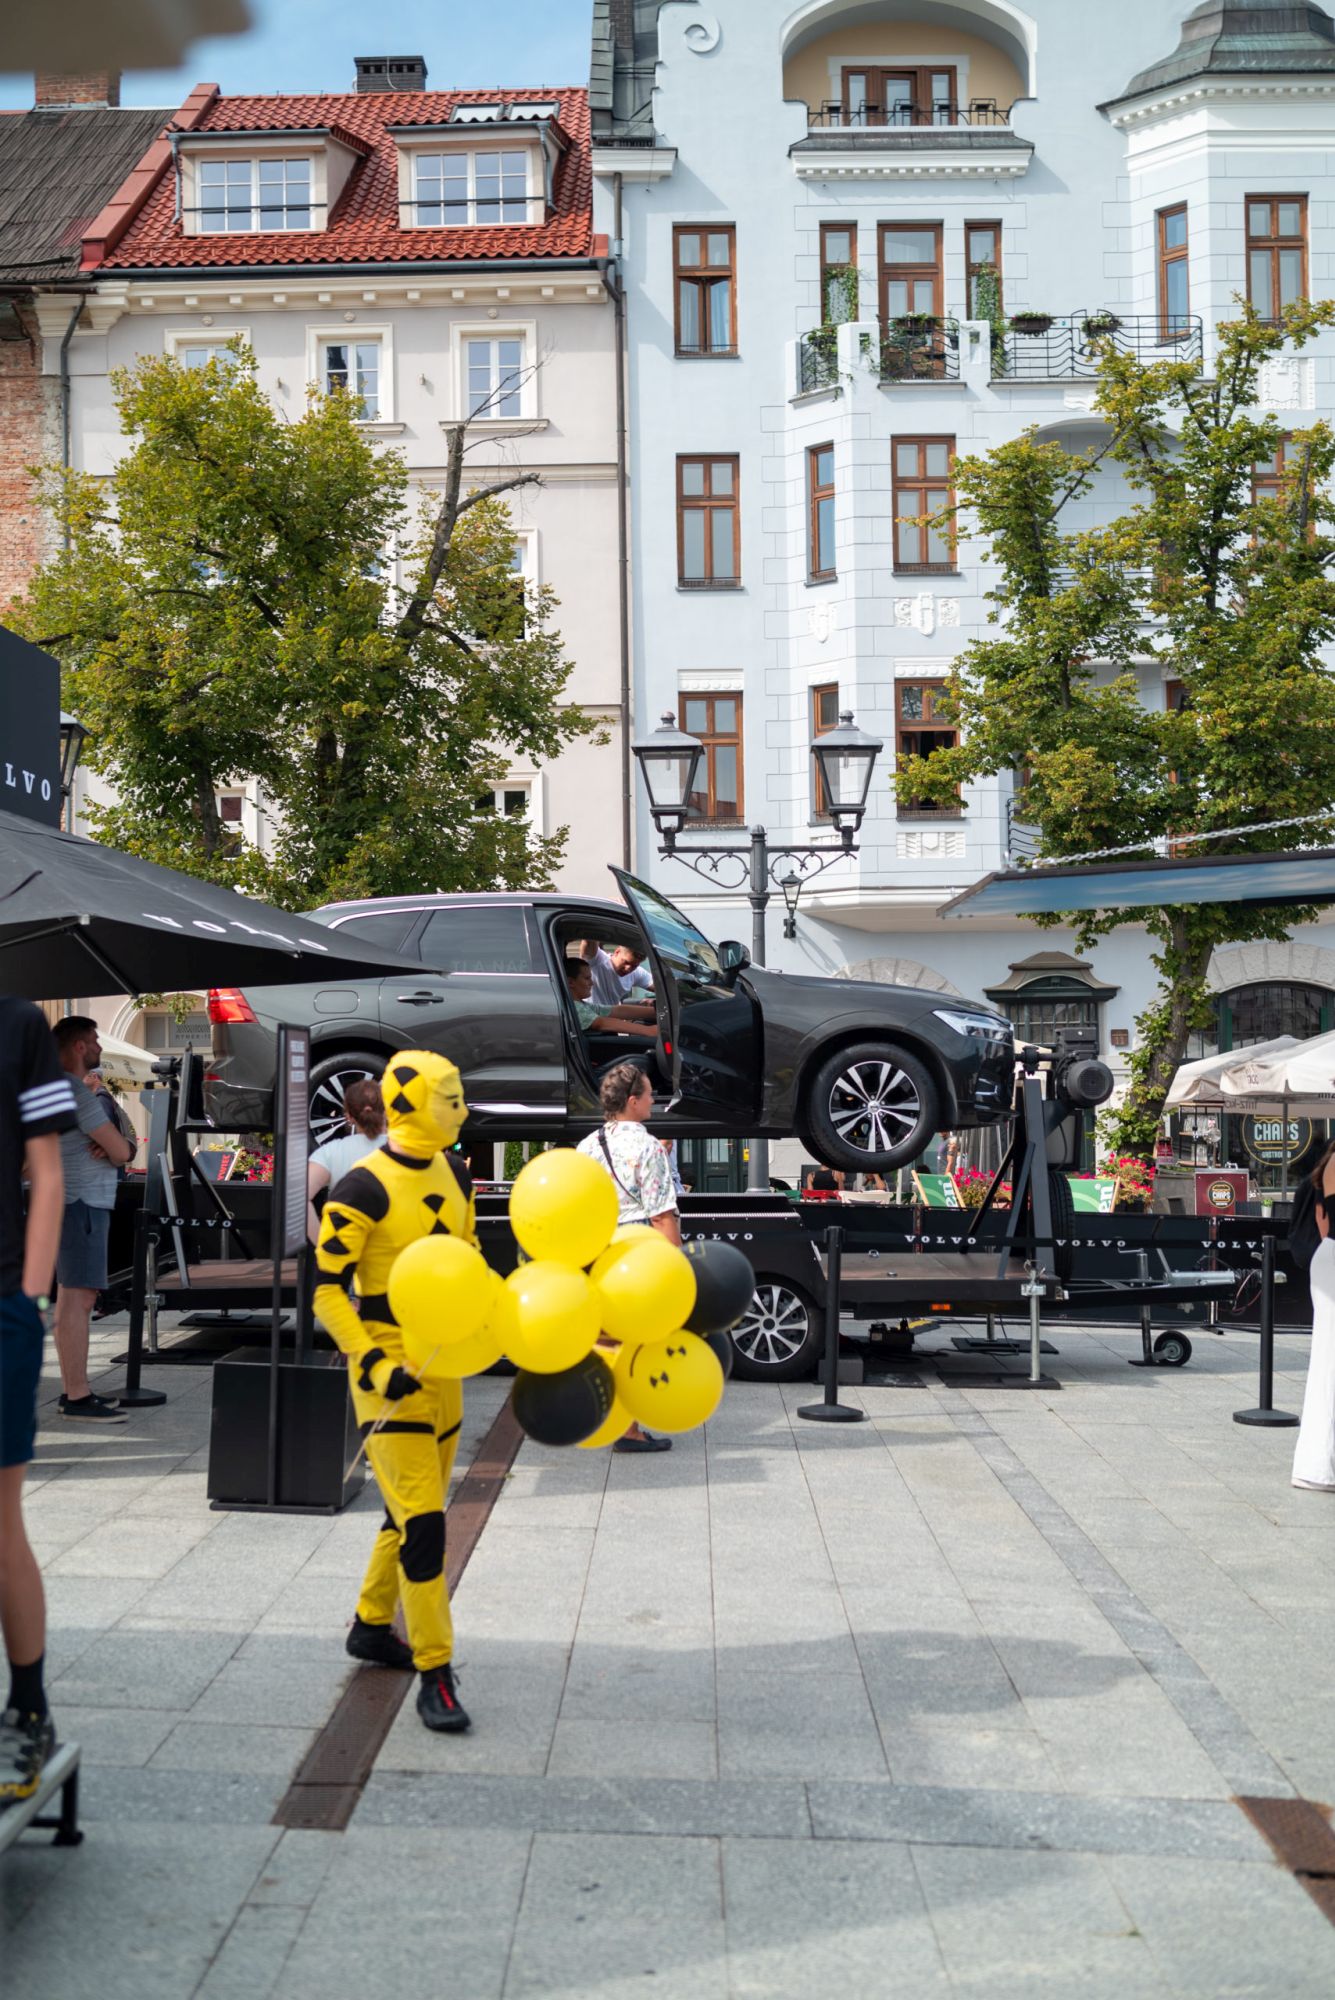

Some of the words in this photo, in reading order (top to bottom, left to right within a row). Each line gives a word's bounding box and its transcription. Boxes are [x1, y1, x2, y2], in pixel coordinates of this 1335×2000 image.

[142, 912, 329, 952] VOLVO
[159, 1216, 232, 1228] VOLVO
[680, 1232, 754, 1241] VOLVO
[904, 1234, 977, 1245] VOLVO
[1056, 1239, 1126, 1247] VOLVO
[1201, 1240, 1265, 1249] VOLV
